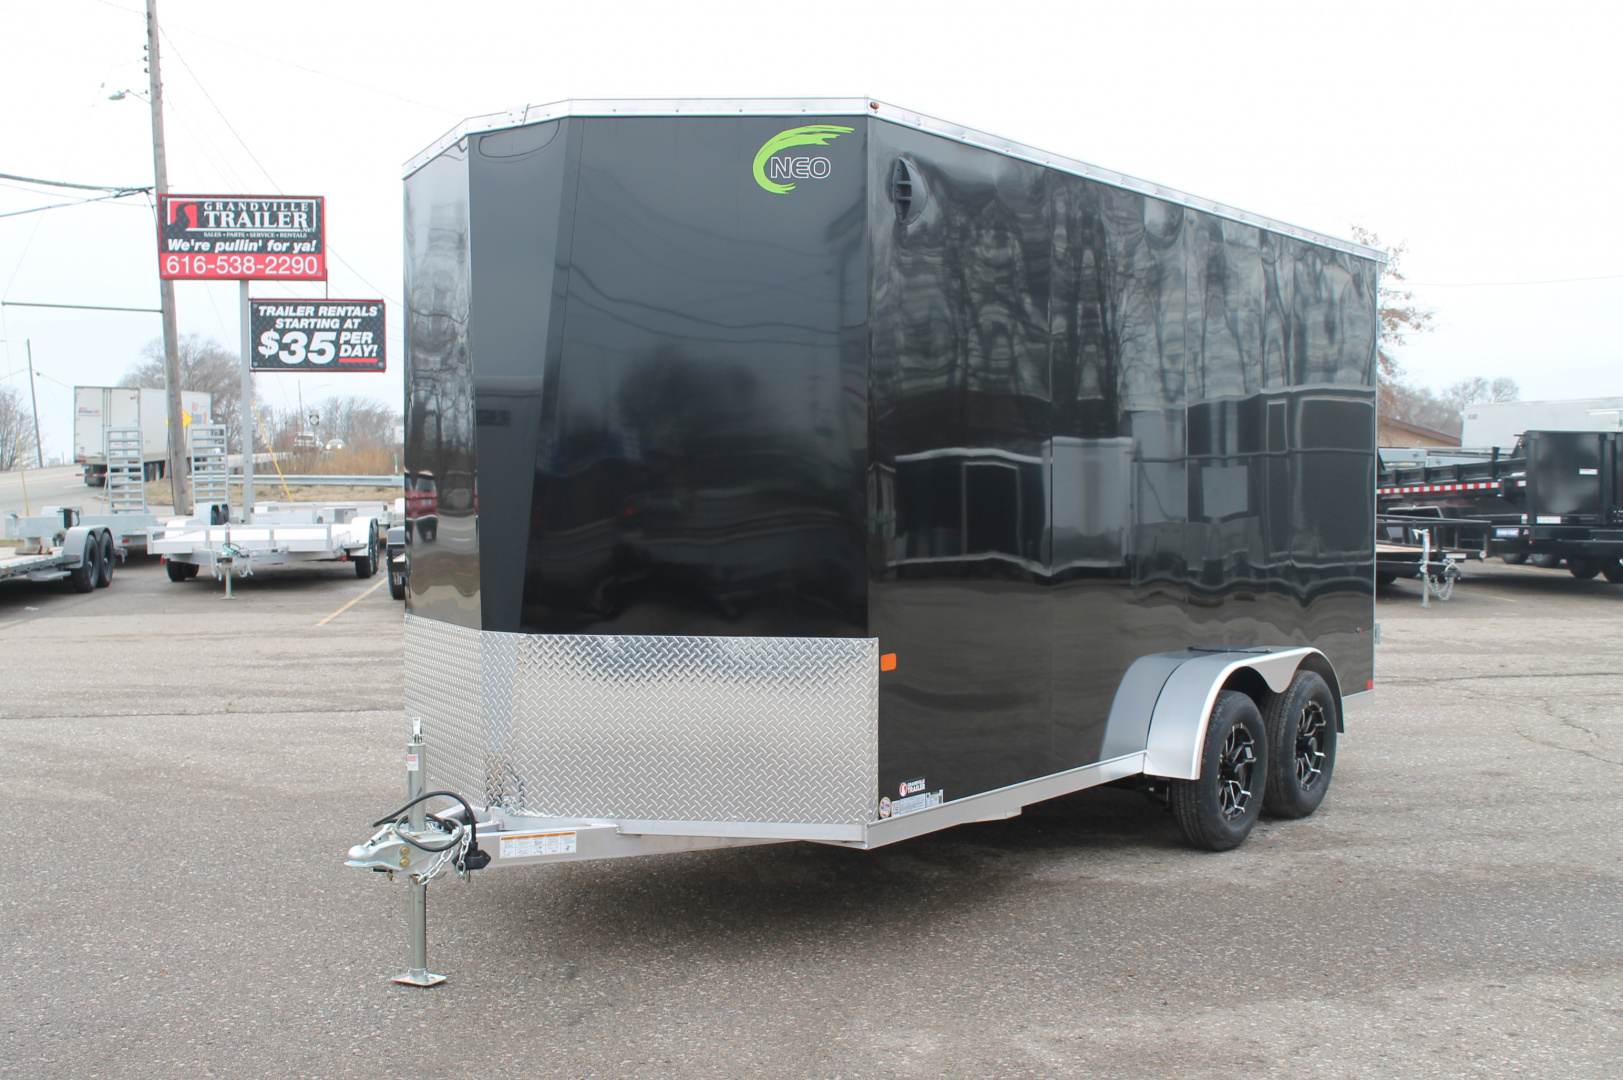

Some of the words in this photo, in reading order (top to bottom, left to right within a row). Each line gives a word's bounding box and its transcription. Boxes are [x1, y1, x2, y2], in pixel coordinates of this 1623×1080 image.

[770, 156, 832, 180] NEO
[204, 201, 309, 212] GRANDVILLE
[203, 211, 309, 228] TRAILER
[167, 238, 211, 251] We're
[214, 239, 262, 253] pullin'
[266, 239, 290, 252] for
[292, 239, 317, 254] ya!
[166, 255, 317, 275] 616-538-2290
[258, 305, 315, 317] TRAILER
[317, 305, 378, 317] RENTALS
[274, 318, 340, 329] STARTING
[342, 318, 362, 329] AT
[257, 328, 337, 365] $35
[339, 331, 374, 344] PER
[339, 344, 379, 357] DAY!
